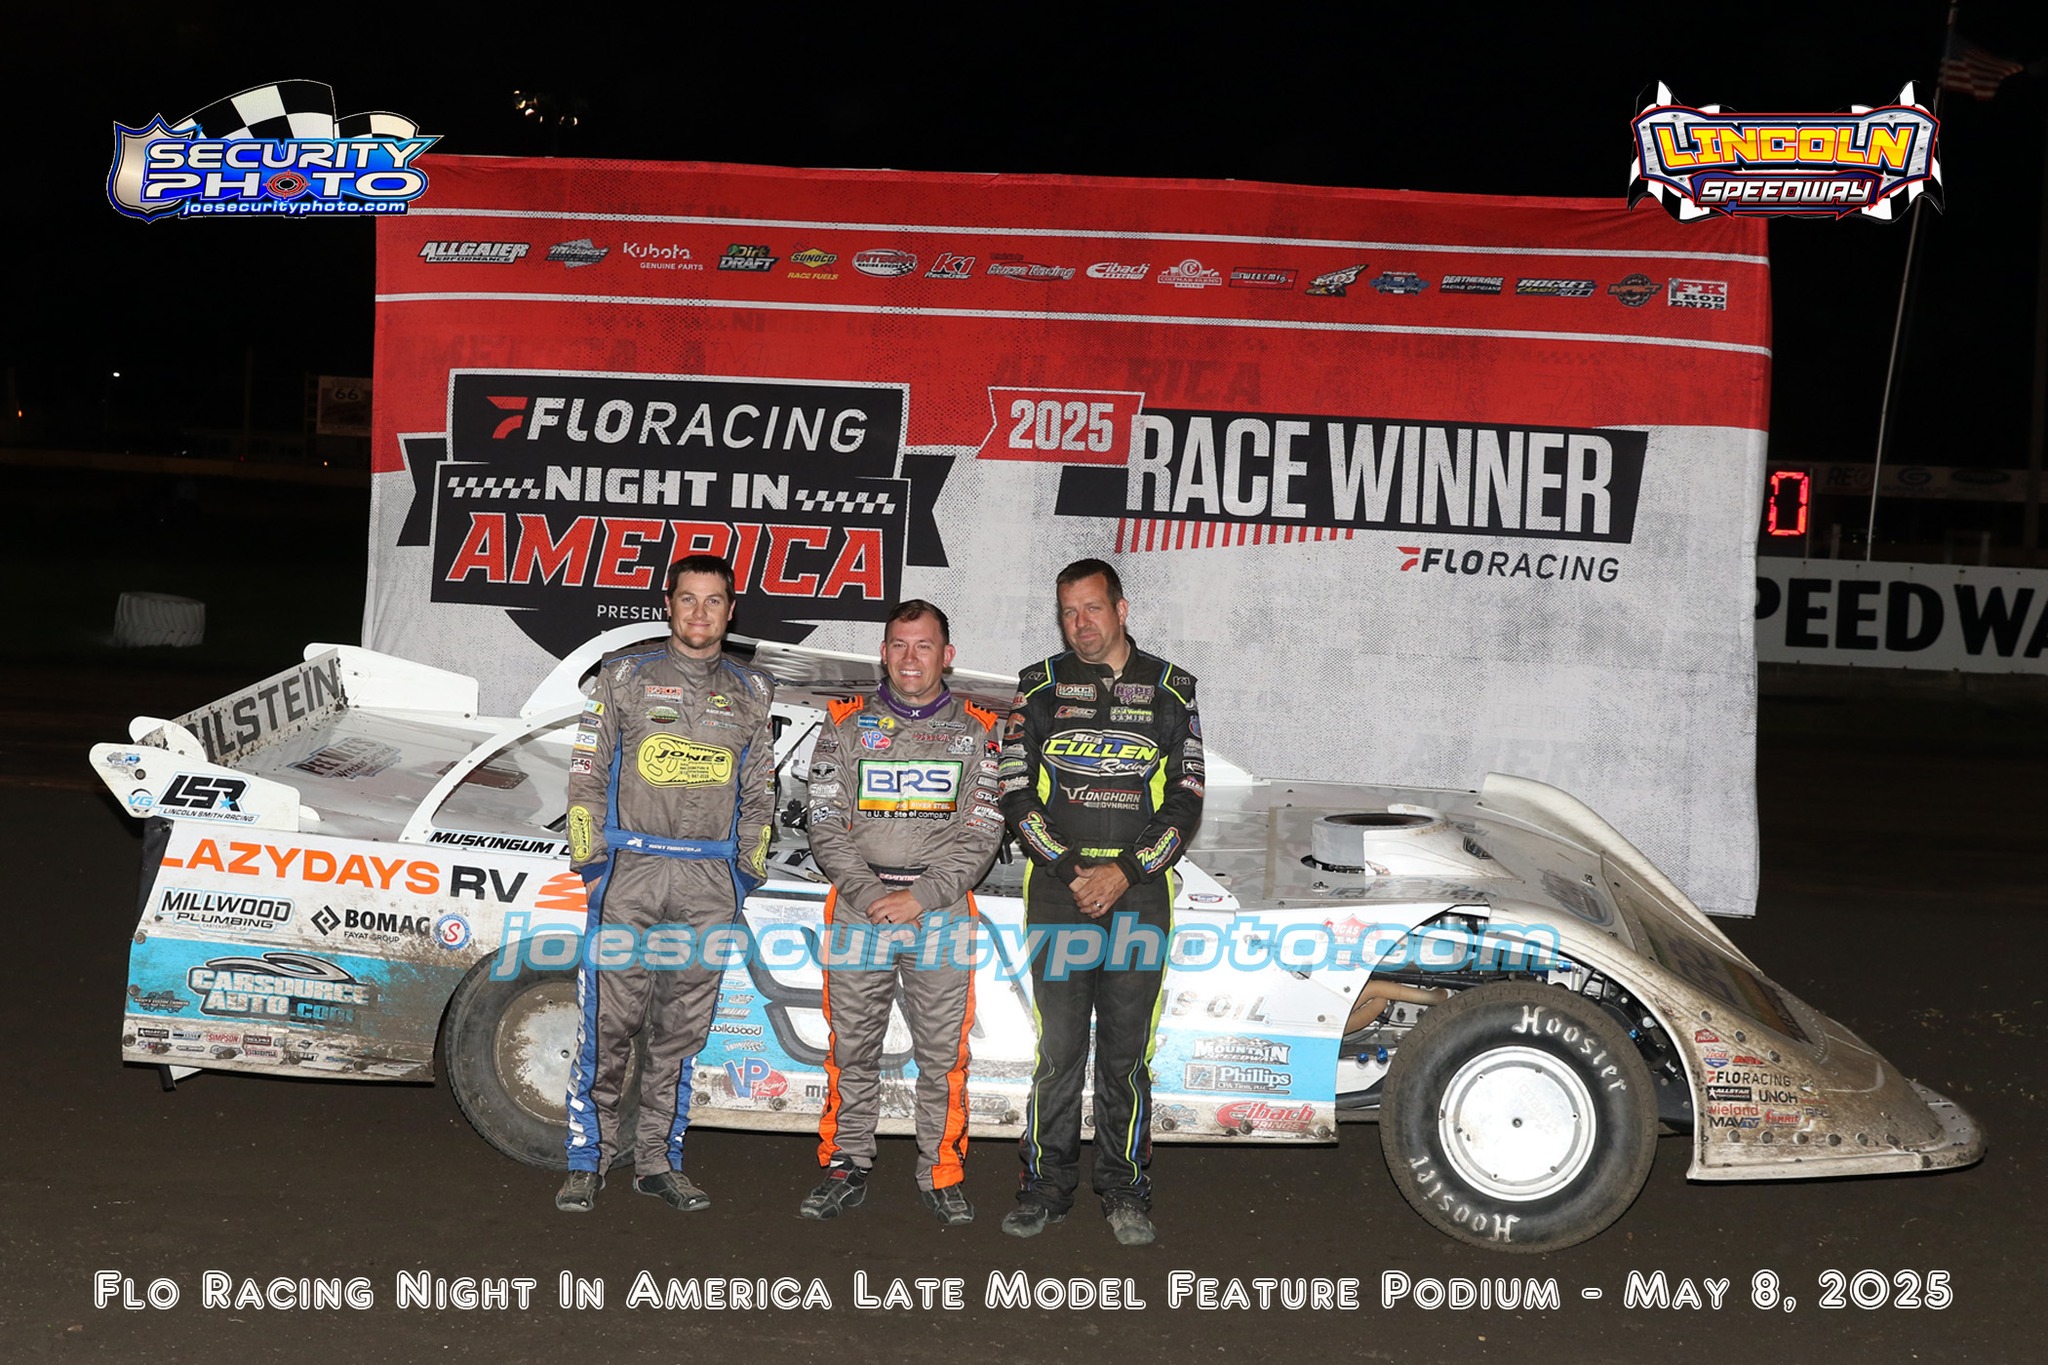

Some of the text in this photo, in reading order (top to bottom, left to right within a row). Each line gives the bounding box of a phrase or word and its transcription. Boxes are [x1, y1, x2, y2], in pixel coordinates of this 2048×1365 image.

[419, 242, 530, 257] ALLGAIER
[623, 242, 692, 260] Kubota
[719, 256, 775, 270] DRAFT
[791, 253, 836, 263] SUNOCO
[931, 252, 976, 274] K1
[640, 262, 704, 271] GENUINE PARTS
[1029, 264, 1076, 280] Racing
[1086, 262, 1151, 279] Eibach
[787, 272, 839, 281] RACE FUELS
[1441, 275, 1505, 286] DEATHERAGE
[1610, 284, 1662, 294] IMPACT
[1670, 301, 1726, 310] ENDS
[1682, 294, 1726, 303] ROD
[334, 388, 359, 400] 66
[526, 395, 869, 454] FLORACING
[1007, 399, 1114, 452] 2025
[1125, 412, 1613, 535] RACE WINNER
[545, 465, 790, 512] NIGHT IN
[1767, 471, 1810, 536] 0
[1421, 547, 1619, 583] FLORACING
[597, 605, 671, 621] PRESENT
[1115, 685, 1154, 697] HOPE
[185, 658, 342, 763] ILSTEIN
[1110, 714, 1153, 722] GAMING
[862, 731, 882, 749] VP
[655, 749, 726, 764] JONES
[1044, 739, 1159, 761] CULLEN
[1094, 758, 1152, 777] Racing
[867, 769, 952, 793] BRS
[127, 795, 154, 807] VG
[159, 774, 247, 812] LSR
[1079, 790, 1142, 803] LONGHORN
[1099, 802, 1140, 811] DYNAMICS
[163, 807, 255, 823] LINCOLN SMITH RACING
[918, 811, 951, 821] company
[429, 831, 555, 855] MUSKINGUM
[450, 865, 529, 904] RV
[161, 891, 292, 922] MILLWOOD
[176, 912, 274, 930] PLUMBING
[345, 908, 431, 937] BOMAG
[344, 931, 401, 944] FAYAT GROUP
[192, 969, 371, 1005] CARSOURCE
[207, 1032, 240, 1044] SIMPSON
[709, 1024, 763, 1036] wilwood
[1194, 1039, 1290, 1064] MOUNTAIN
[723, 1057, 770, 1099] VP
[1220, 1066, 1291, 1088] Phillips
[1716, 1070, 1792, 1087] FLORACING
[1715, 1087, 1750, 1095] ALLSTAR
[1758, 1089, 1799, 1104] UNOH
[1216, 1102, 1316, 1130] Eibach
[1707, 1102, 1760, 1117] wieland
[1252, 1119, 1301, 1131] PRINGS
[1709, 1116, 1761, 1129] MAVTV
